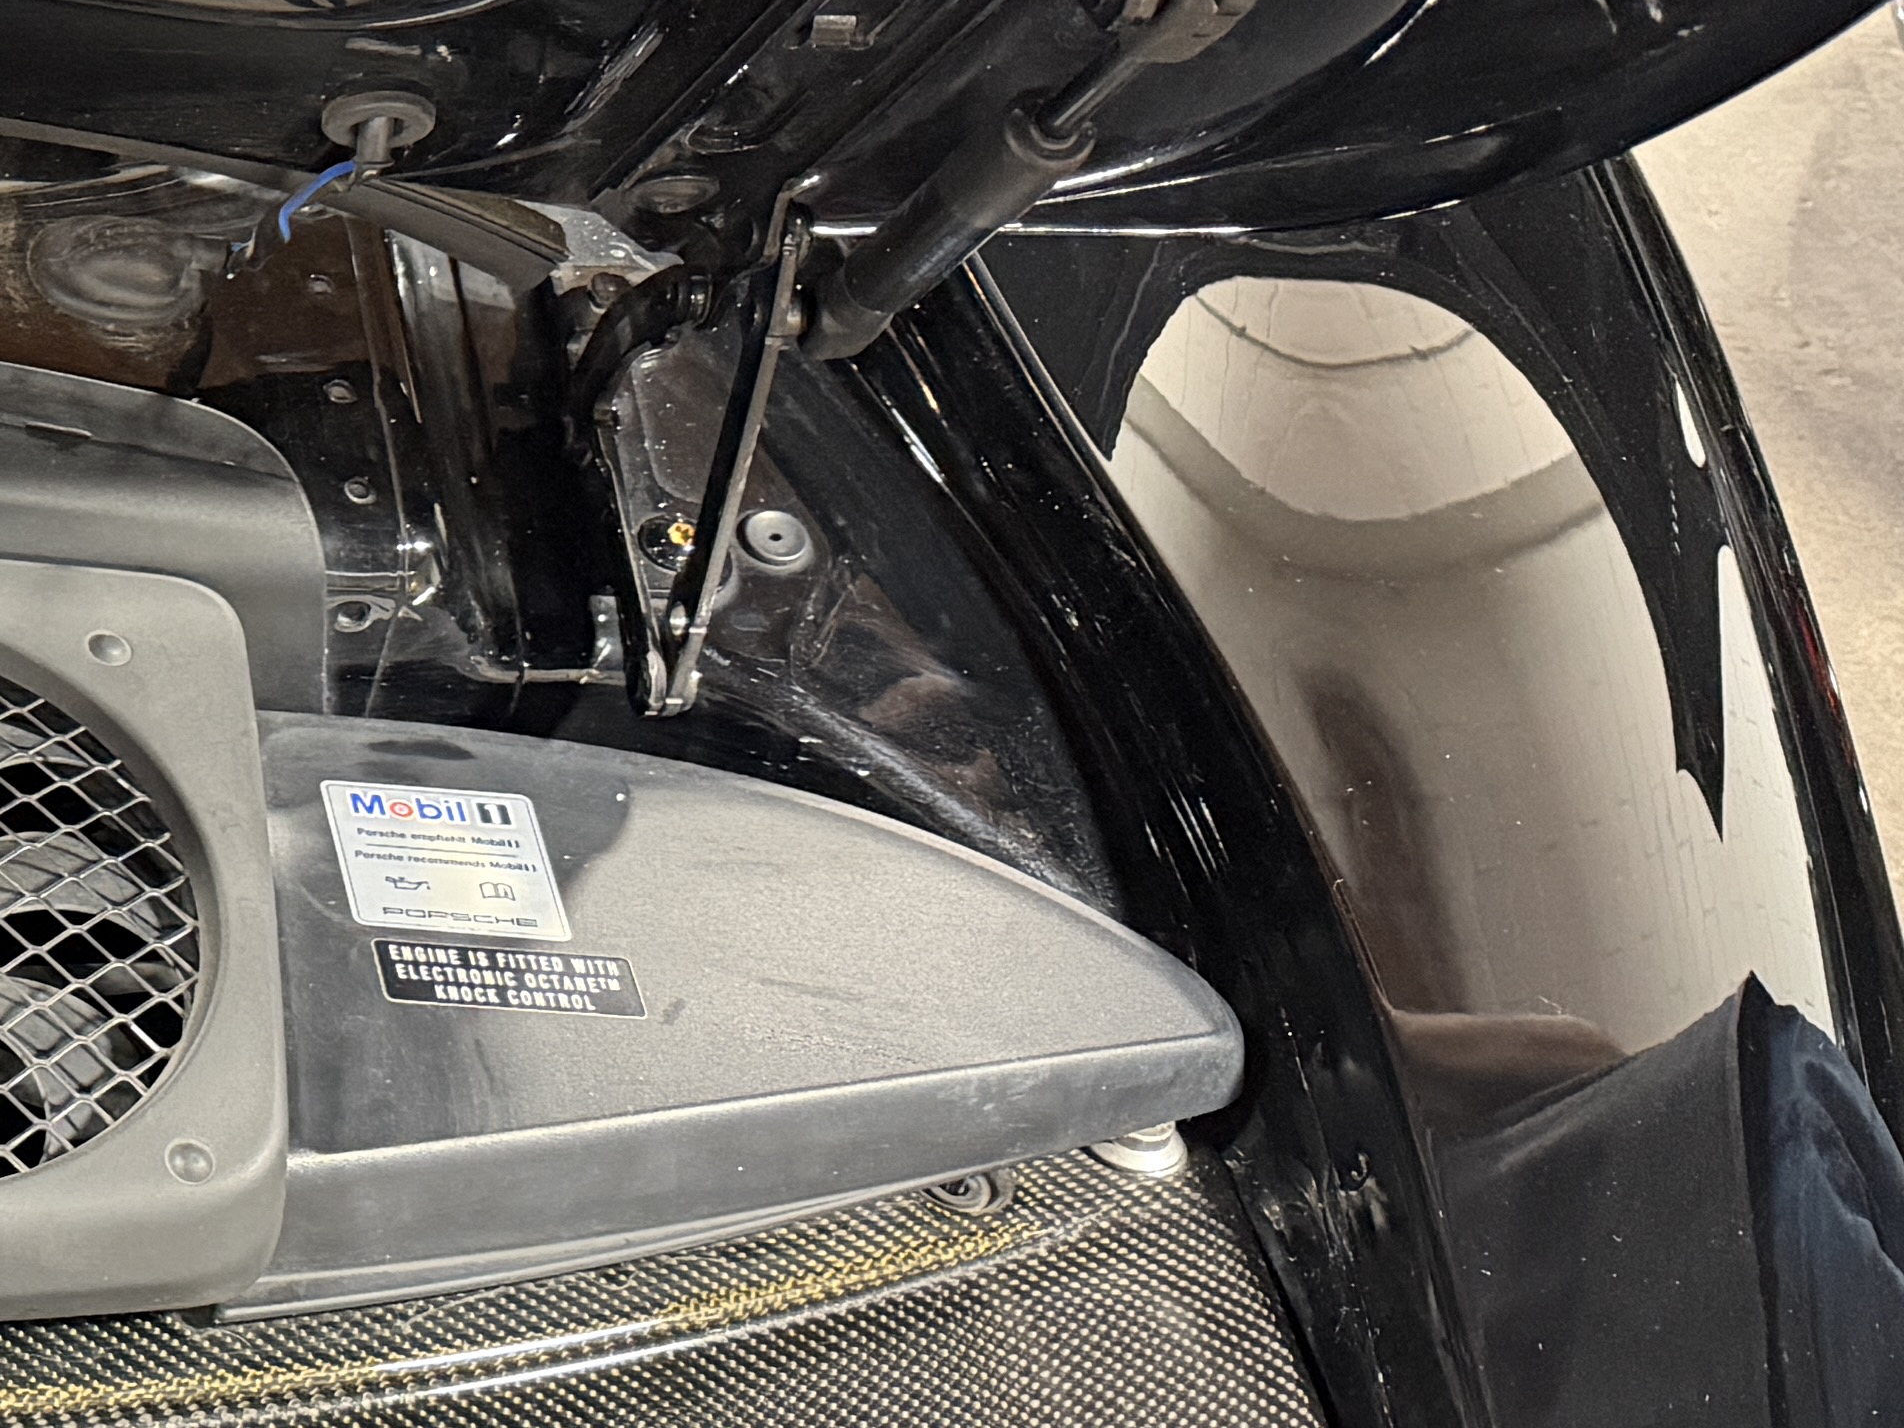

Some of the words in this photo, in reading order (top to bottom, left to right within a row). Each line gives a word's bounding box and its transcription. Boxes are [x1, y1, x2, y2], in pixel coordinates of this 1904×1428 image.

[350, 792, 466, 822] Mobil
[479, 802, 509, 825] 1
[356, 827, 407, 839] Porsche
[471, 836, 505, 848] Mobil
[354, 849, 404, 862] Porsche
[407, 855, 486, 869] recommends
[489, 860, 523, 872] Mobil
[382, 905, 539, 928] PORSCHE
[388, 943, 462, 965] ENGINE
[468, 950, 490, 967] IS
[495, 952, 564, 972] FITTED
[570, 957, 620, 977] WITH
[395, 963, 517, 987] ELECTRONIC
[434, 984, 501, 1003] KNOCK
[507, 988, 596, 1011] CONTROL
